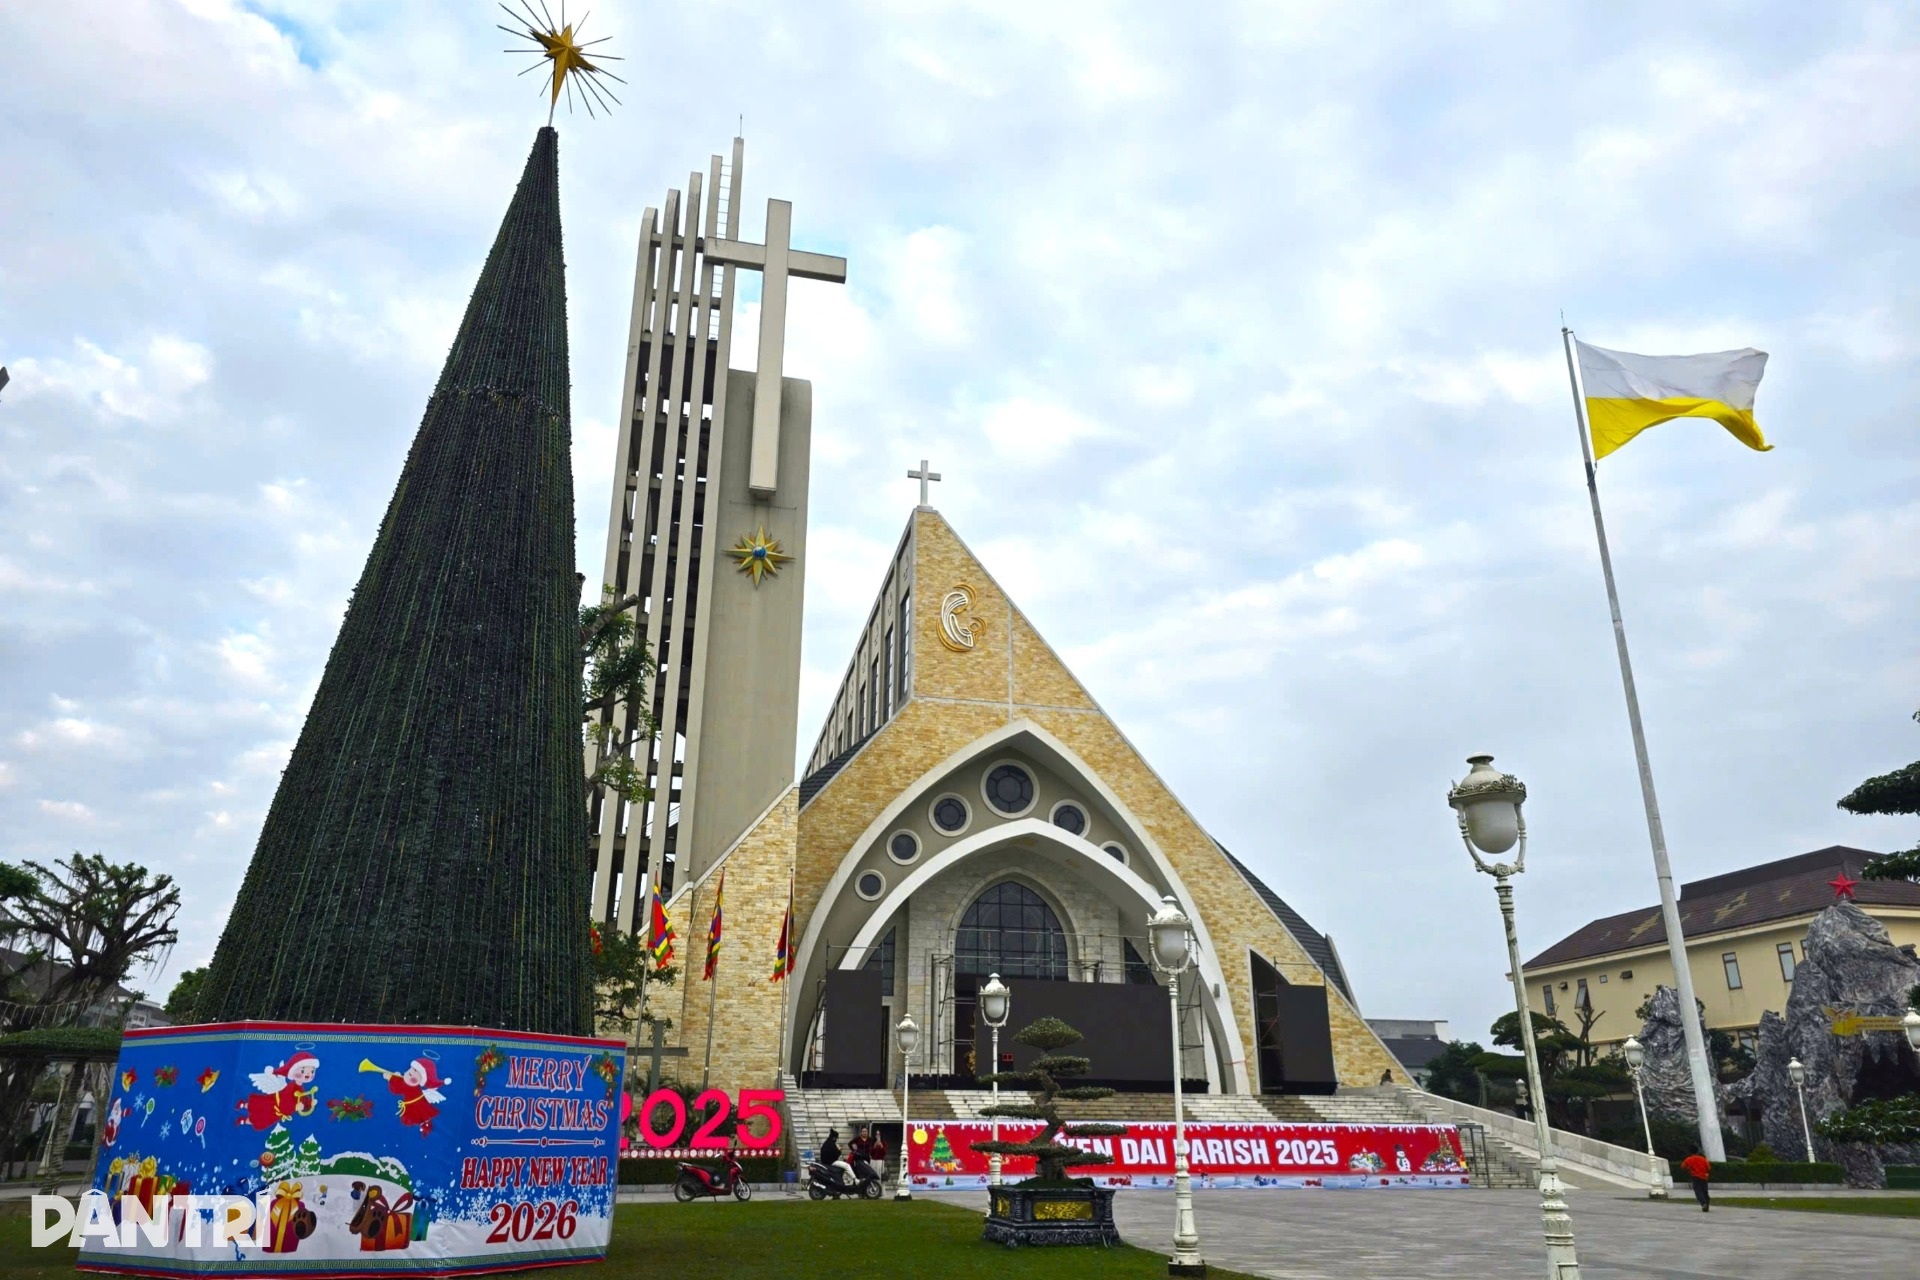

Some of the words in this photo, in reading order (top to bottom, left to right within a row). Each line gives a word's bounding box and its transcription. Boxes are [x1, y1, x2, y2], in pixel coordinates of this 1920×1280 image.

[505, 1055, 592, 1093] MERRY
[475, 1095, 609, 1133] CHRISTMAS
[620, 1088, 785, 1149] 025
[1120, 1138, 1167, 1165] DAI
[1172, 1138, 1271, 1165] PARISH
[1275, 1139, 1339, 1165] 2025
[460, 1157, 526, 1189] HAPPY
[527, 1156, 567, 1188] NEW
[568, 1155, 609, 1187] YEAR
[485, 1200, 579, 1244] 2026
